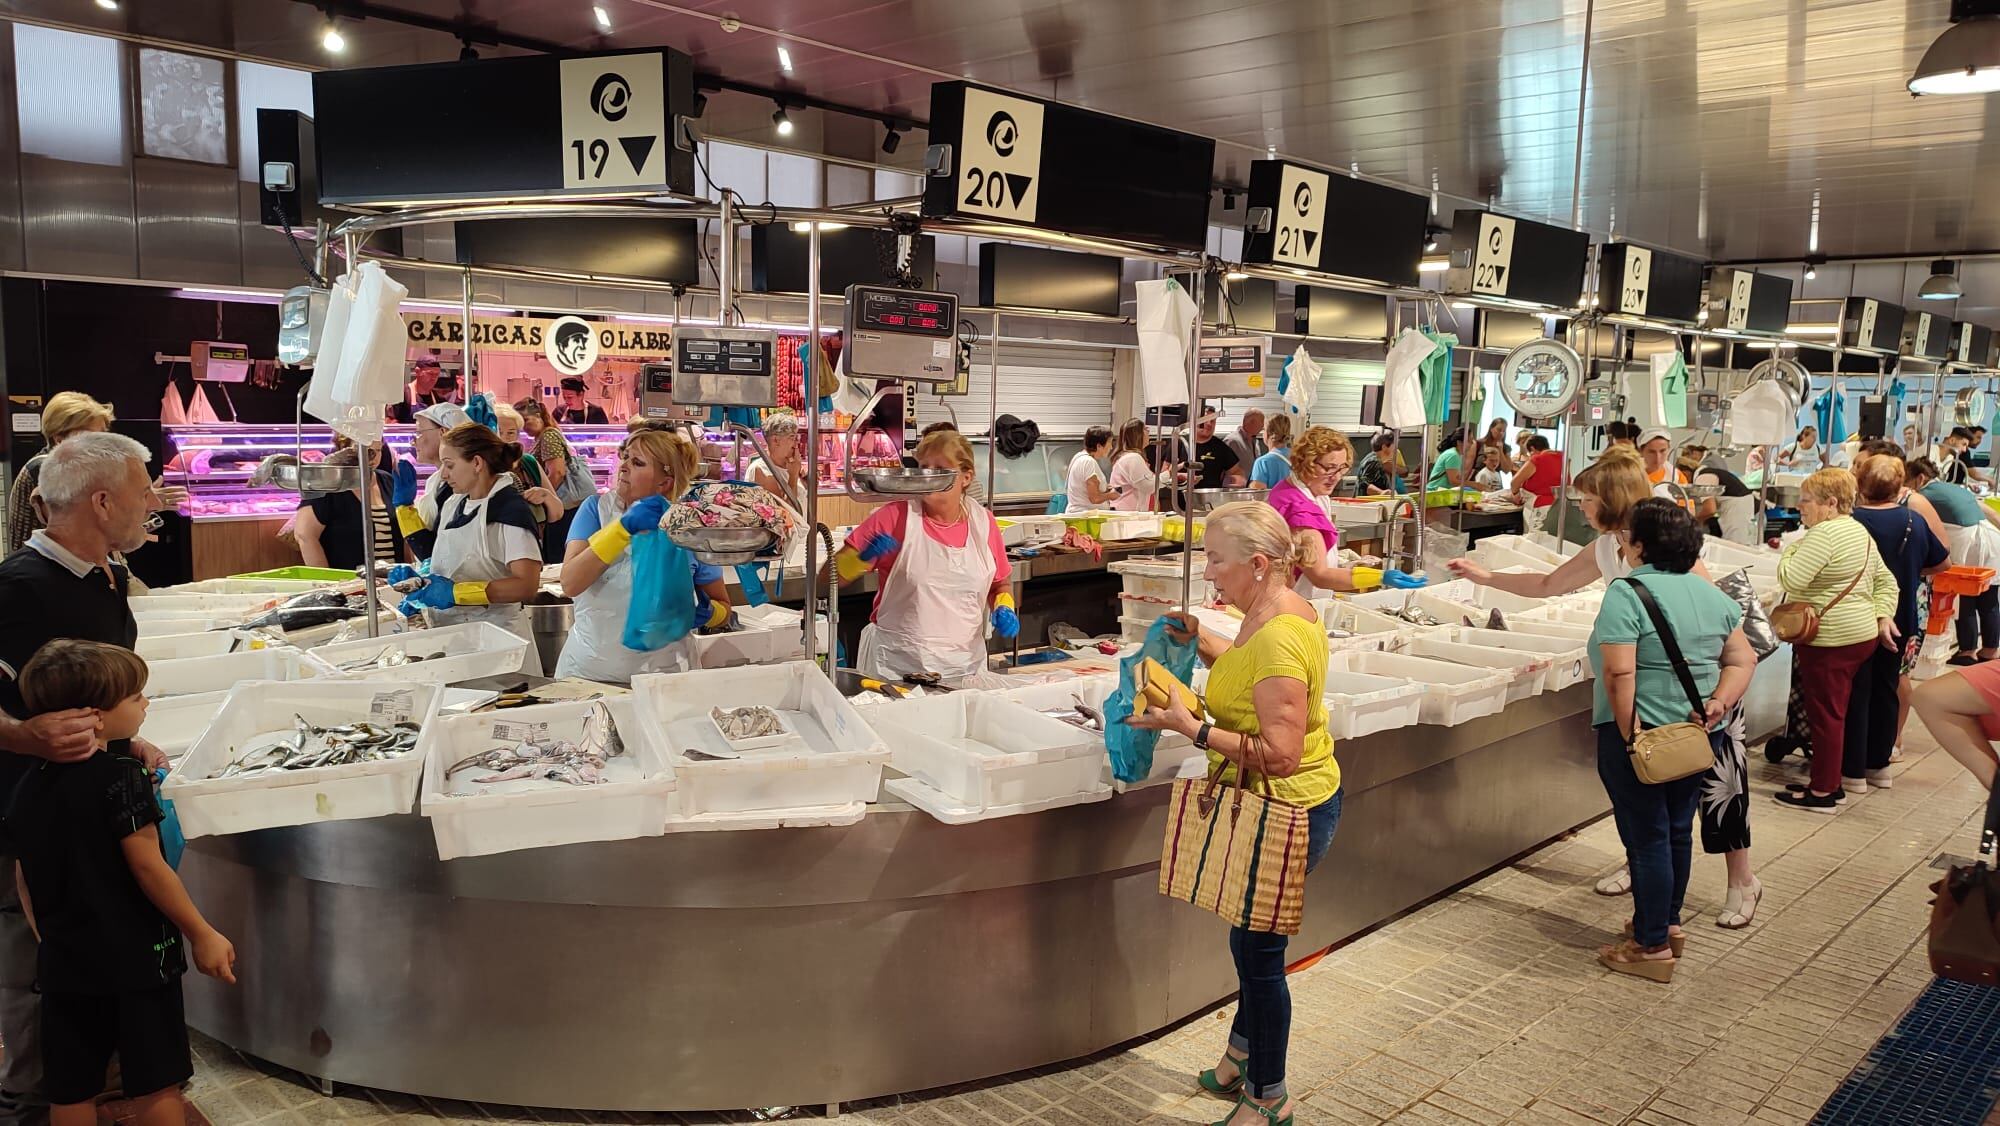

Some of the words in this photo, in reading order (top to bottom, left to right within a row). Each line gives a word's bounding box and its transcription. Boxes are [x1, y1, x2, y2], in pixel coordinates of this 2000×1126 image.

[571, 138, 610, 181] 19
[964, 167, 1005, 209] 20
[1278, 226, 1299, 258] 21
[1476, 263, 1494, 288] 22
[1623, 287, 1637, 309] 23
[600, 330, 615, 349] O
[618, 331, 672, 351] LABR
